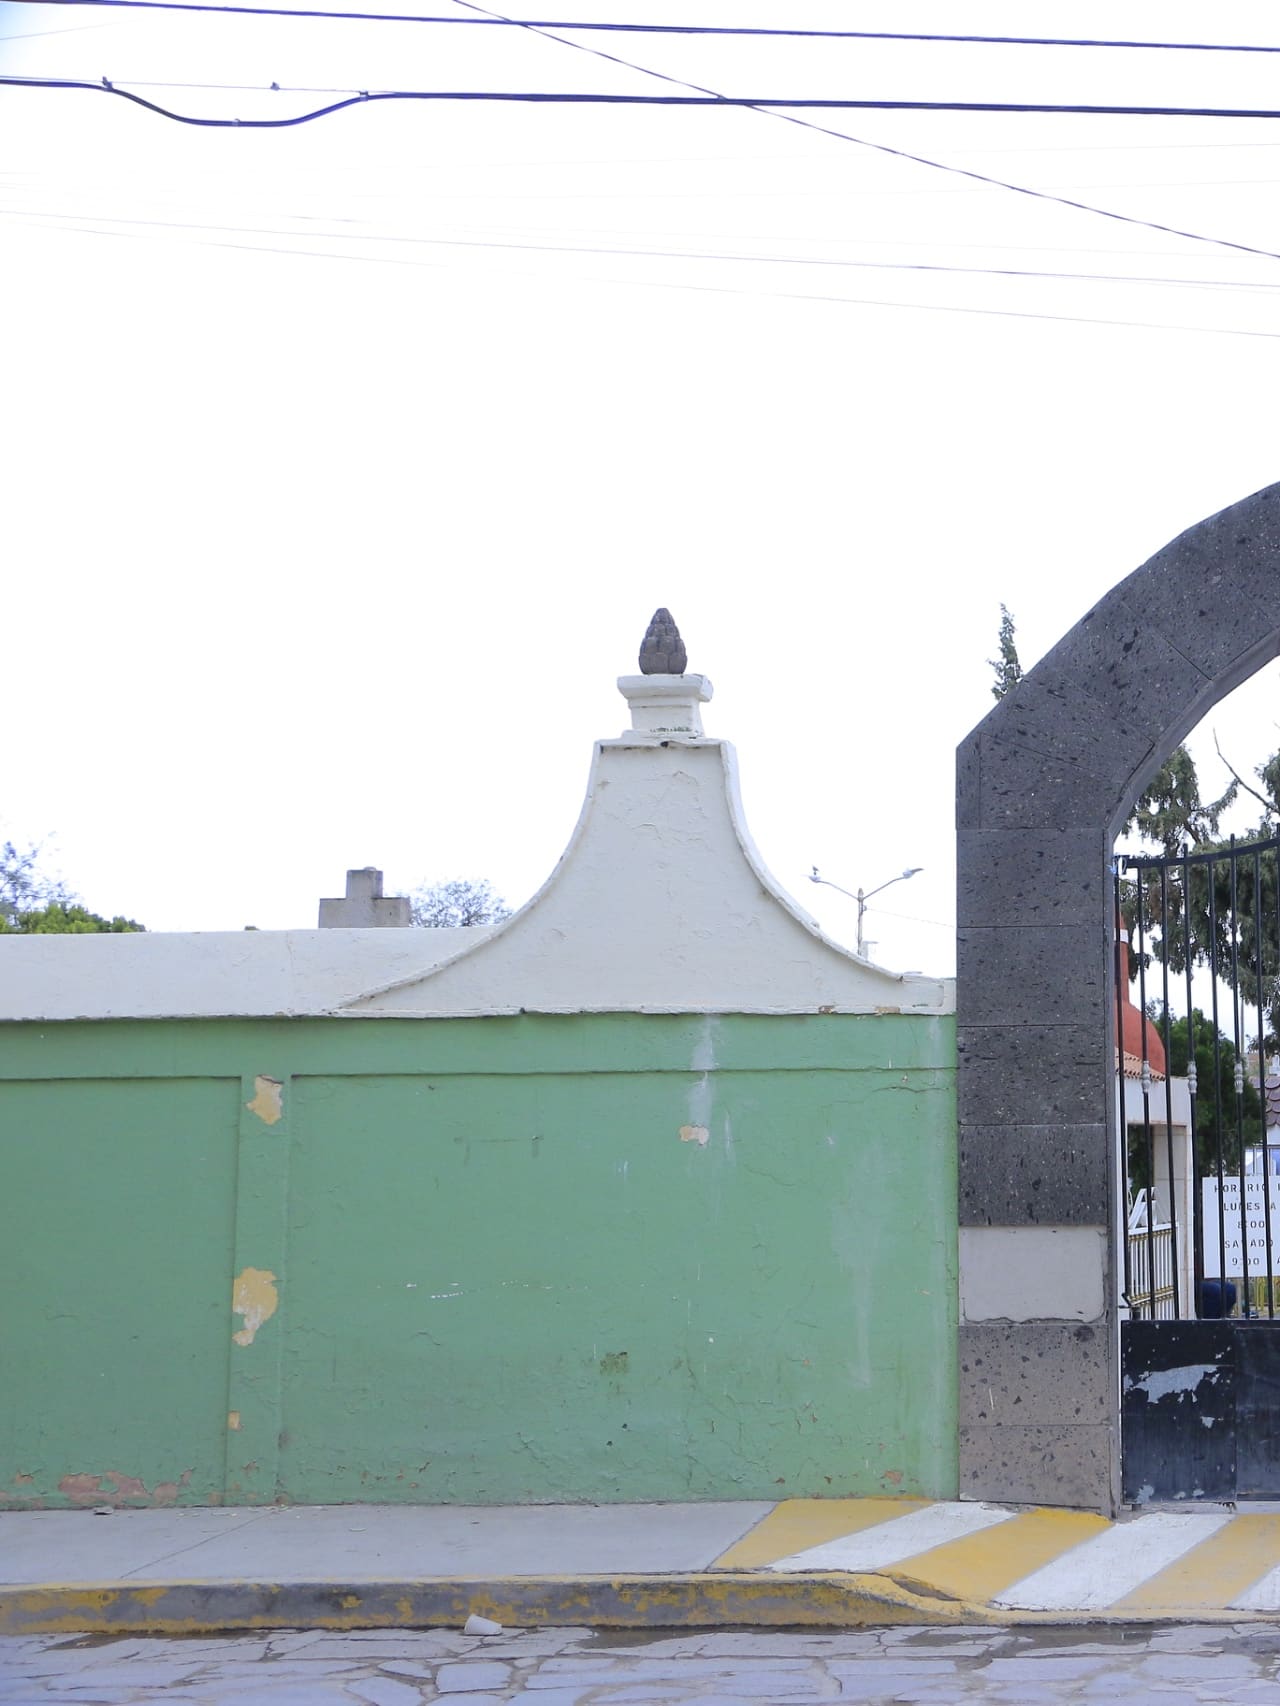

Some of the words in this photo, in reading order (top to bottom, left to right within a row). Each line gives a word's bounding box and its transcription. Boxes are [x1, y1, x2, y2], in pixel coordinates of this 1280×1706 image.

[1214, 1183, 1267, 1193] HORRIO
[1270, 1202, 1276, 1210] A
[1224, 1240, 1274, 1249] SAAD
